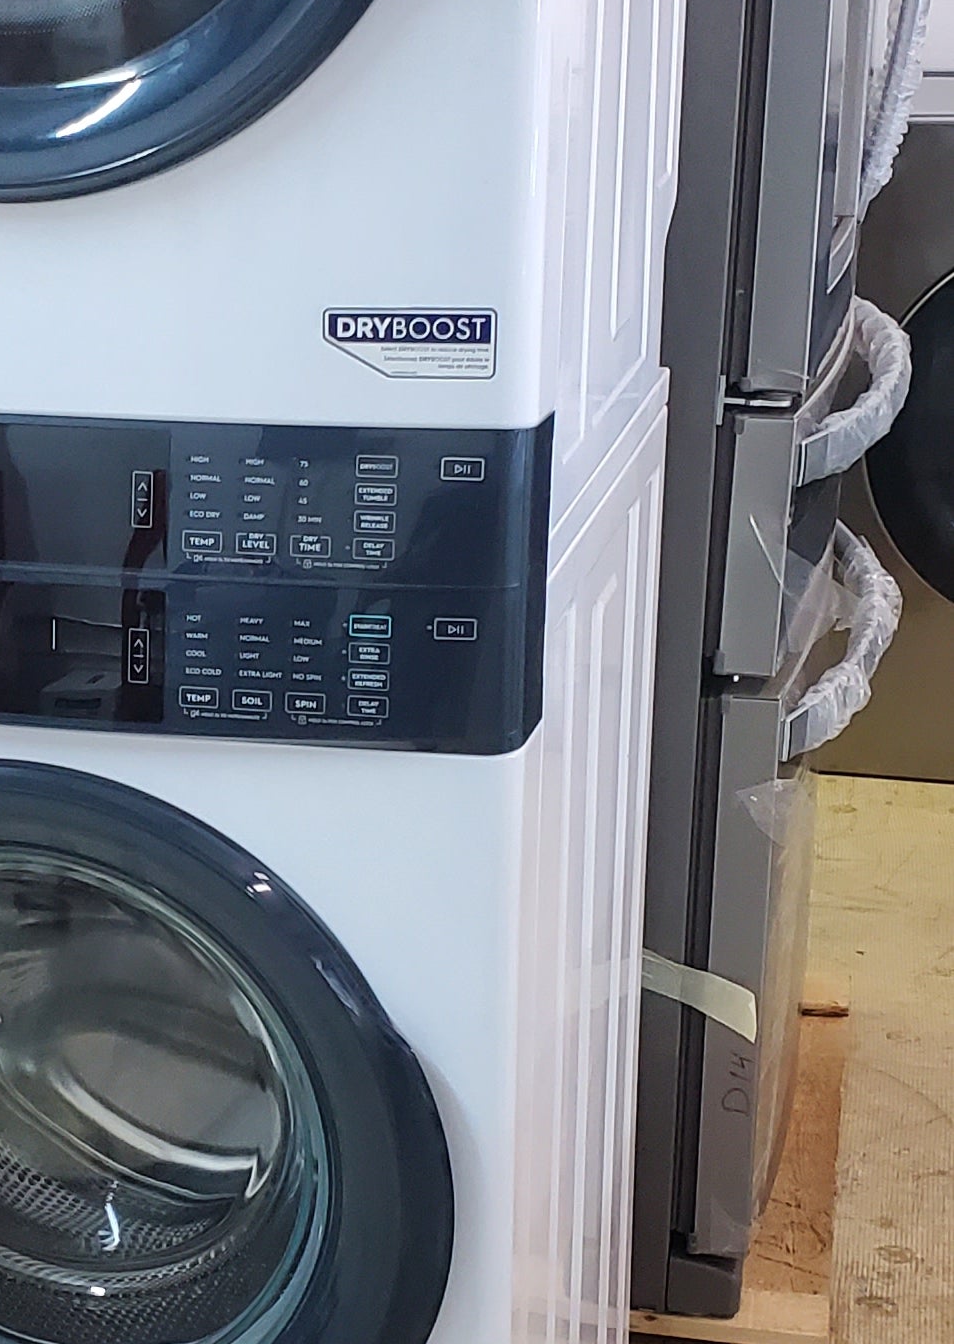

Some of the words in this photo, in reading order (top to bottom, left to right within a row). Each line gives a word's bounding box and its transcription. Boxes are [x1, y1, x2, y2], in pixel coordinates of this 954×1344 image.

[336, 316, 487, 340] DRYBOOST
[245, 458, 264, 466] HIGH
[190, 474, 222, 483] NORMAL
[244, 476, 276, 485] NORMAL
[189, 492, 207, 500] LOW
[244, 494, 261, 502] LOW
[189, 510, 204, 518] ECO
[206, 511, 221, 519] DRY
[243, 512, 265, 521] DAMP
[189, 537, 215, 547] TEMP
[302, 535, 319, 543] DRY
[242, 540, 270, 550] LEVEL
[298, 542, 321, 553] TIME
[186, 614, 202, 622] HOT
[239, 617, 264, 625] HEAVY
[186, 632, 208, 640] WARM
[239, 634, 270, 643] NORMAL
[293, 638, 323, 646] MEDIUM
[185, 649, 207, 657] COOL
[239, 652, 260, 660] LIGHT
[293, 655, 310, 663] LOW
[185, 667, 200, 675] ECO
[201, 668, 222, 676] COLD
[238, 669, 261, 678] EXTRA
[262, 671, 282, 679] LIGHT
[292, 673, 305, 681] NO
[185, 693, 212, 703] TEMP
[241, 696, 263, 706] SOIL
[295, 699, 317, 709] SPIN
